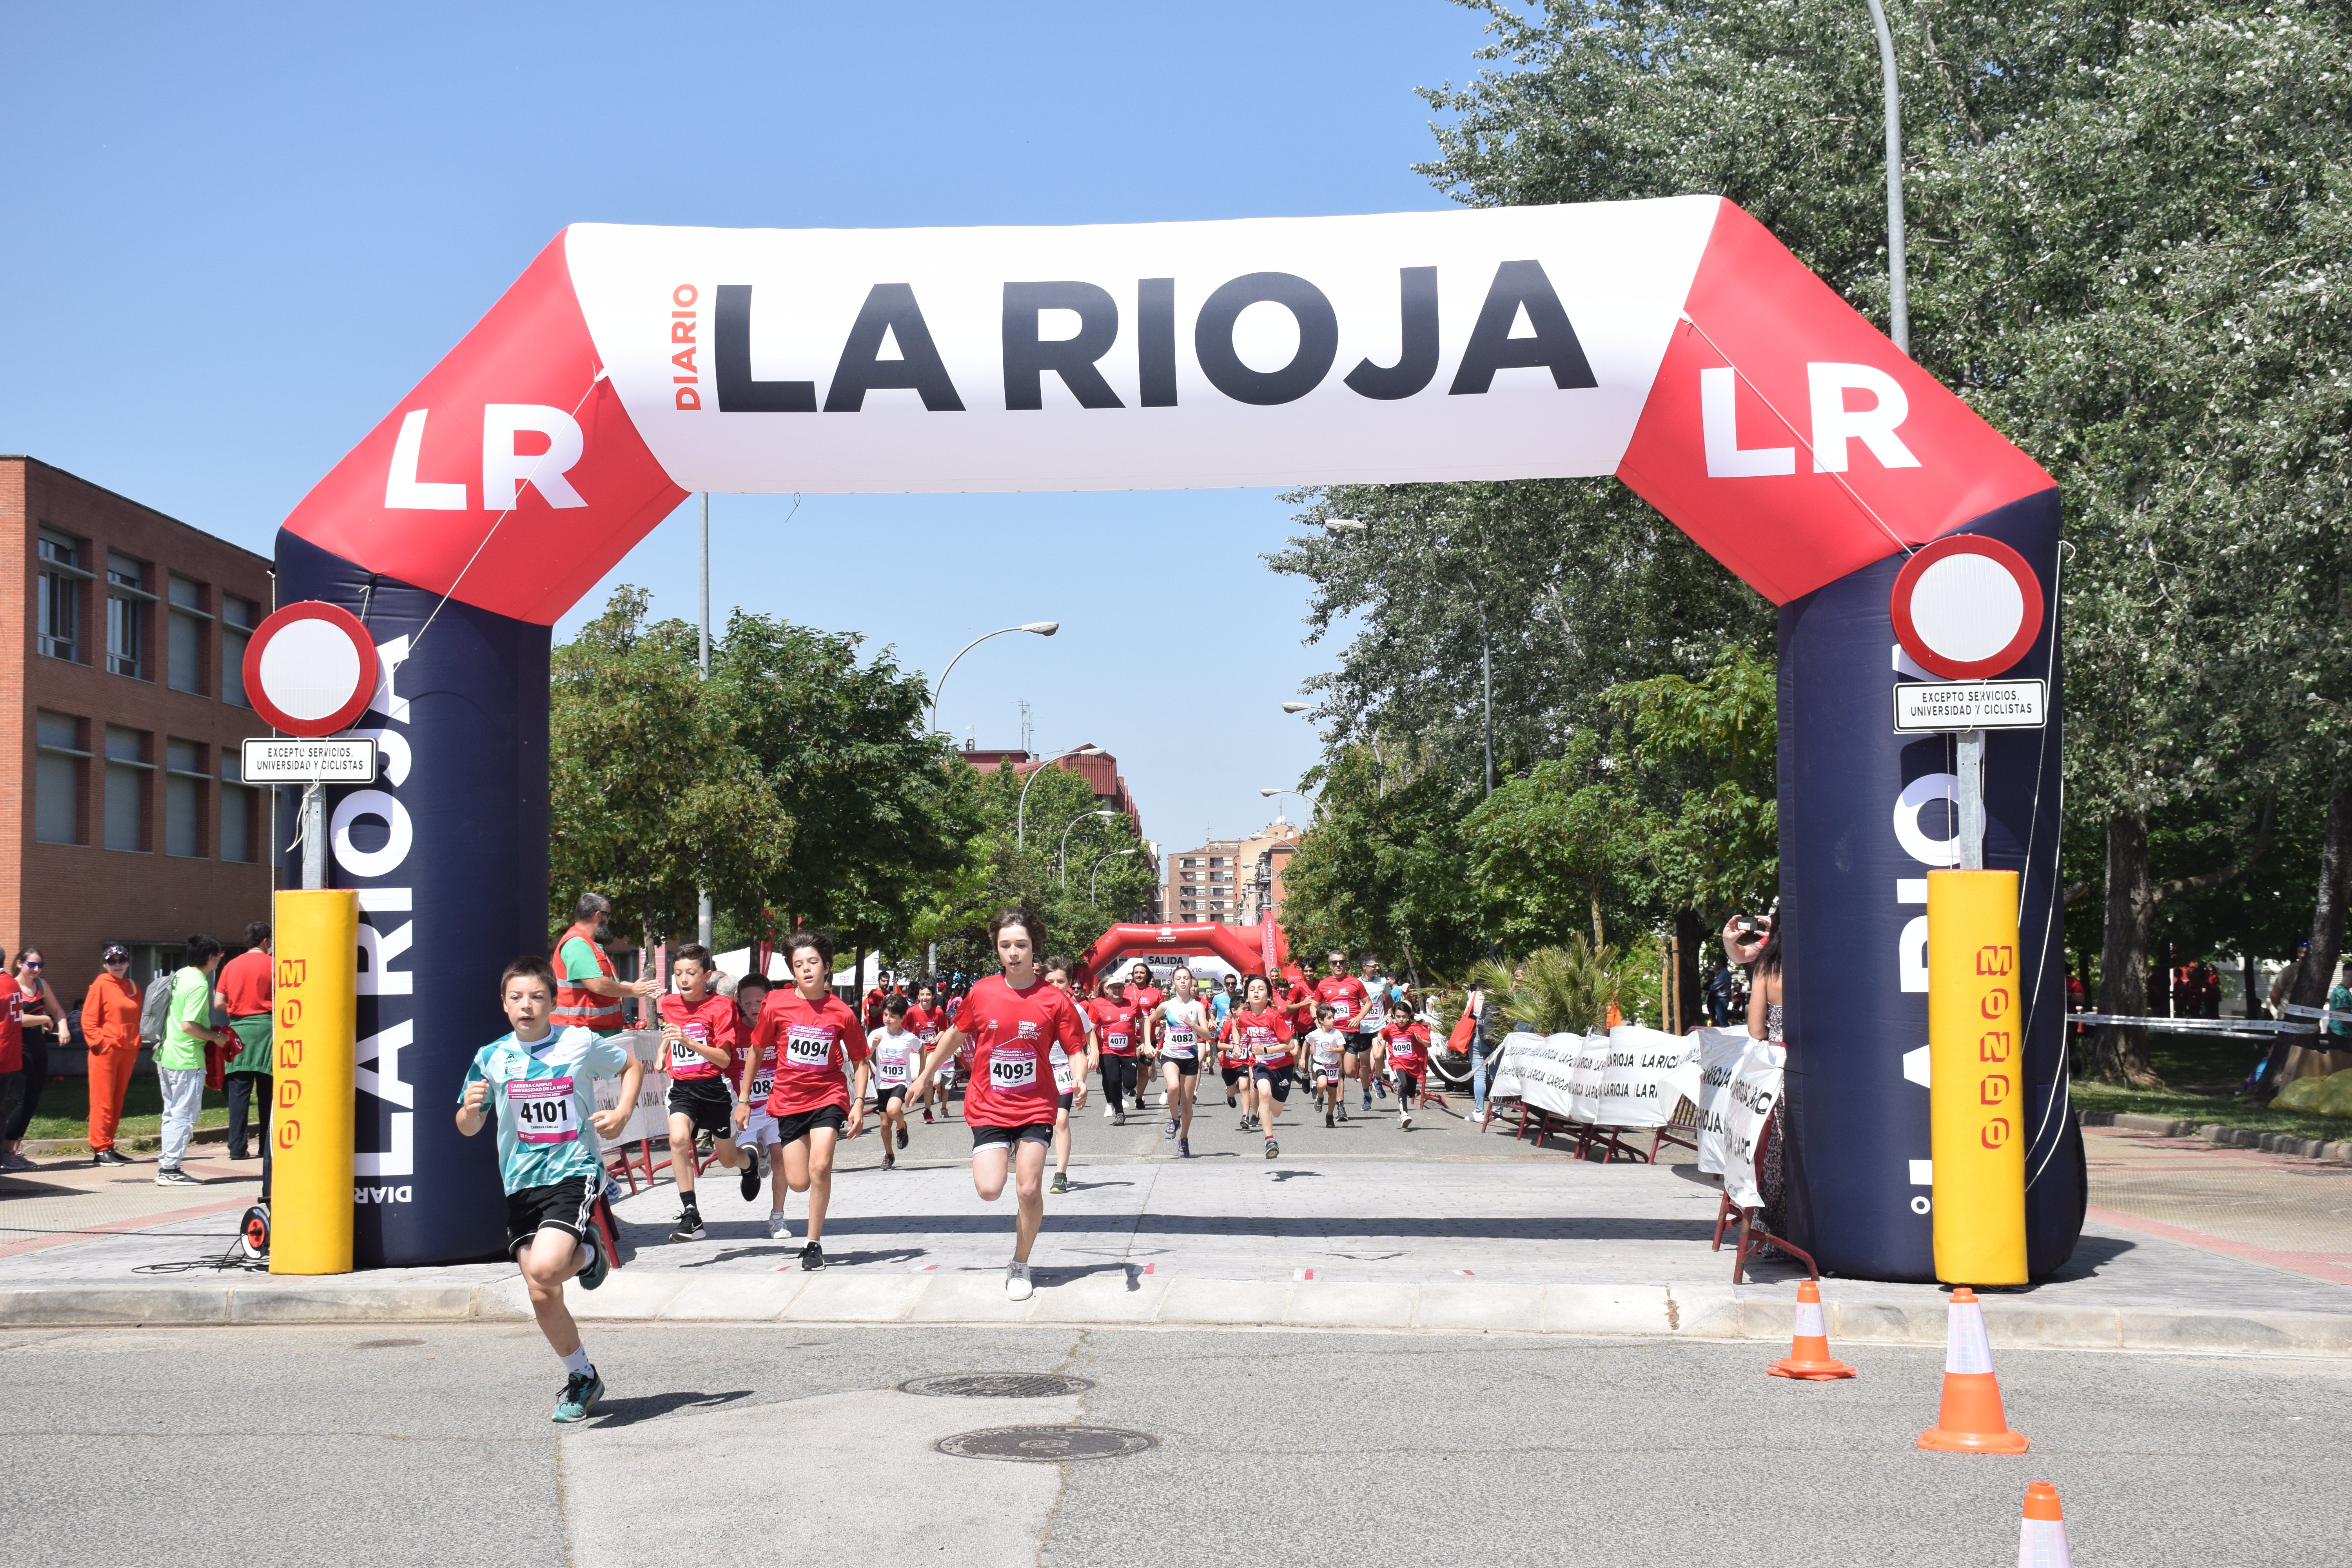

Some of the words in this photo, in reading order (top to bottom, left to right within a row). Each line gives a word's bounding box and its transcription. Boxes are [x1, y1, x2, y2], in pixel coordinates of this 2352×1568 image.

[715, 282, 966, 413] LA
[1002, 259, 1599, 410] RIOJA
[671, 283, 701, 412] DIARIO
[1700, 362, 1922, 478] LR
[385, 404, 589, 510] LR
[1922, 691, 1964, 702] EXCEPTO
[1968, 690, 2020, 701] SERVICIOS,
[1911, 704, 1972, 716] UNIVERSIDAD
[1975, 705, 1980, 715] Y
[1984, 703, 2032, 715] CICLISTAS
[268, 748, 305, 757] EXCEPTO
[308, 748, 353, 758] SERVICIOS,
[257, 760, 310, 770] UNIVERSIDAD
[314, 760, 318, 770] Y
[321, 760, 363, 770] CICLISTAS
[1148, 956, 1184, 965] SALIDA
[1171, 1034, 1193, 1043] 4082
[279, 959, 306, 1149] MONDO
[790, 1039, 829, 1057] 4094
[1976, 945, 2013, 1149] MONDO
[1613, 1053, 1634, 1067] RIOJA
[1641, 1054, 1655, 1068] LA
[882, 1065, 904, 1075] 4103
[993, 1062, 1033, 1080] 4093
[1058, 1070, 1073, 1083] 410
[750, 1080, 774, 1095] 08
[1609, 1083, 1630, 1097] RIOJA
[1636, 1083, 1647, 1098] LA
[521, 1099, 568, 1123] 4101
[354, 1185, 412, 1203] DIAR
